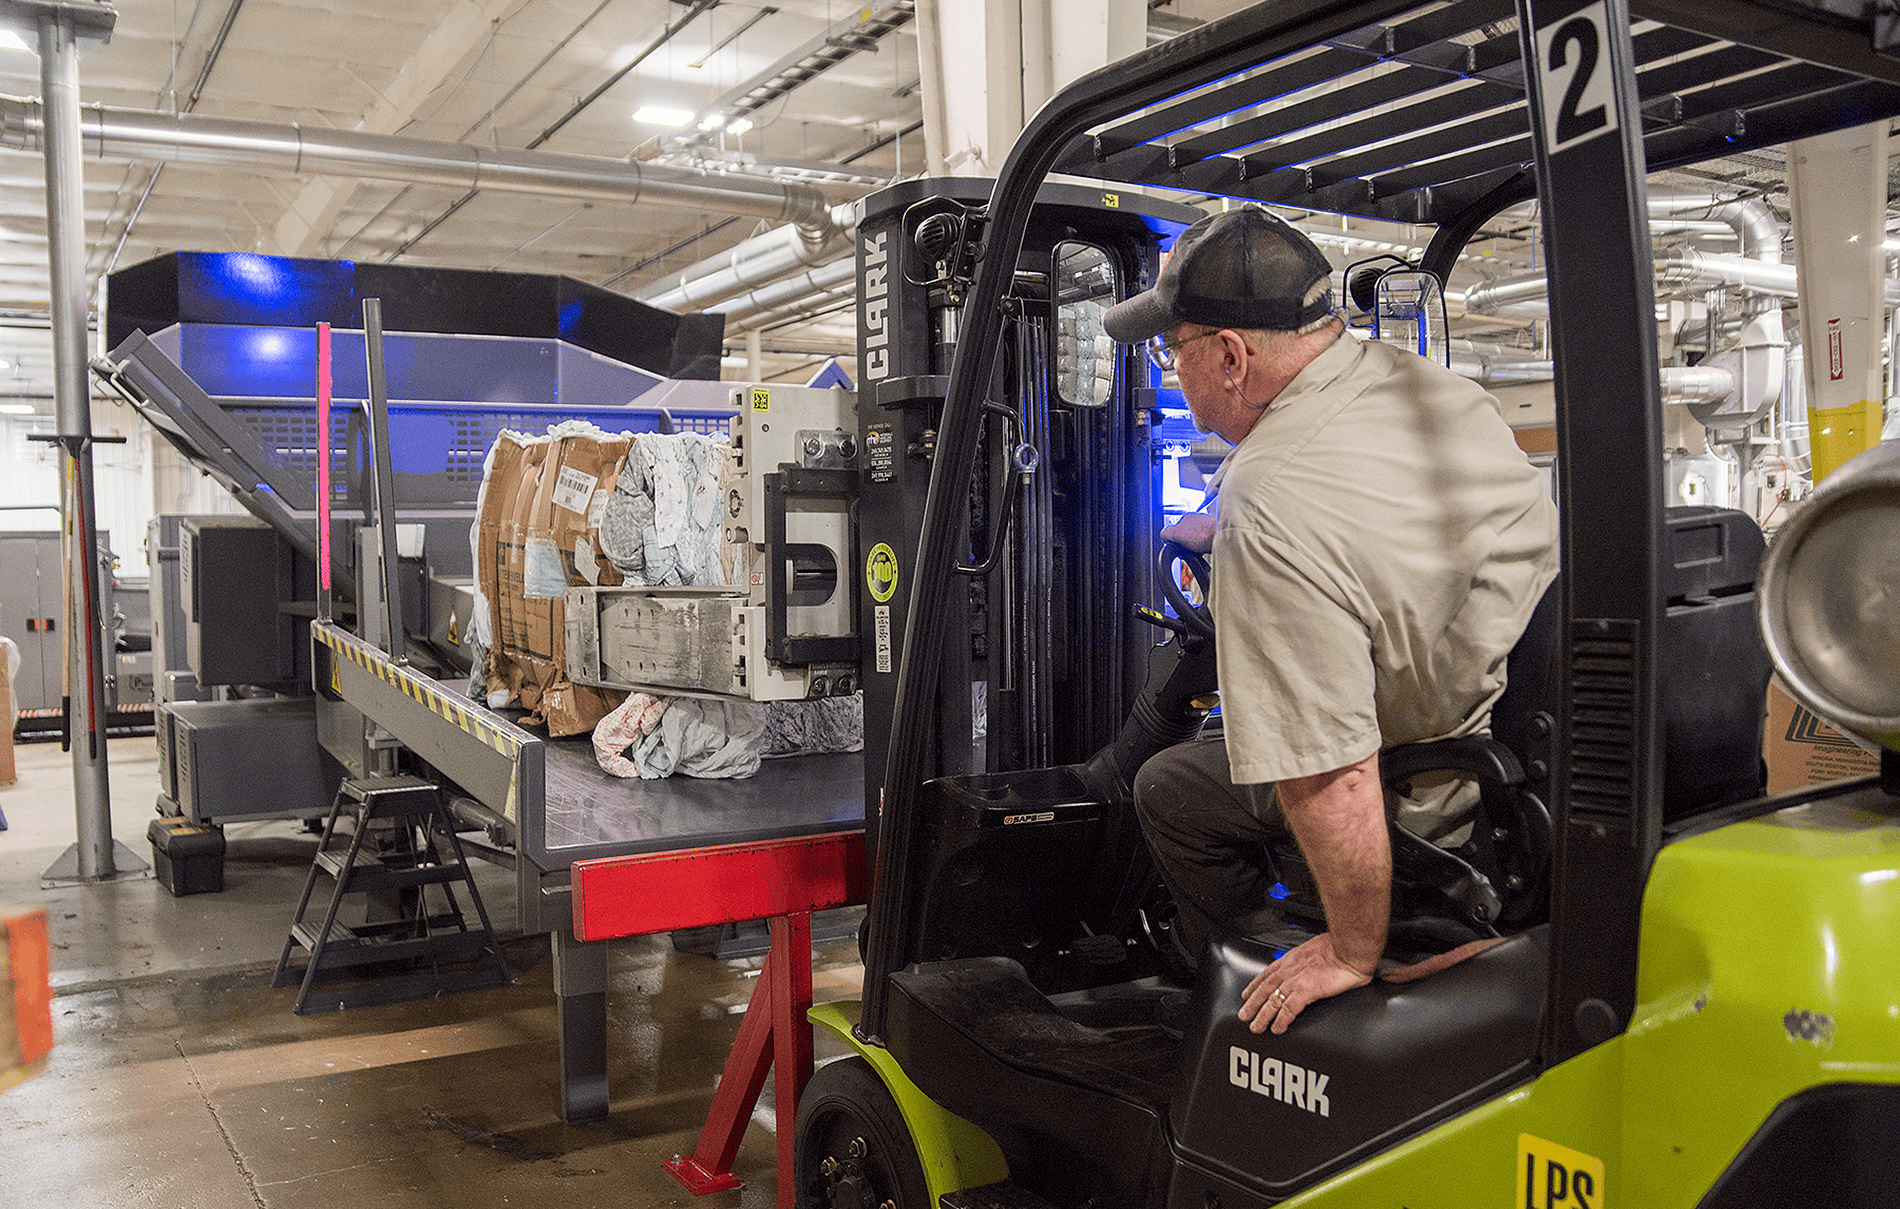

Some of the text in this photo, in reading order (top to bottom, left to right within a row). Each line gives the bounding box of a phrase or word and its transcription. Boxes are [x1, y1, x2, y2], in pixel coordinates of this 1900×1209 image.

[1549, 15, 1607, 145] 2
[864, 231, 889, 381] CLARK
[1813, 744, 1863, 757] Imagineering
[1229, 1045, 1330, 1118] CLARK
